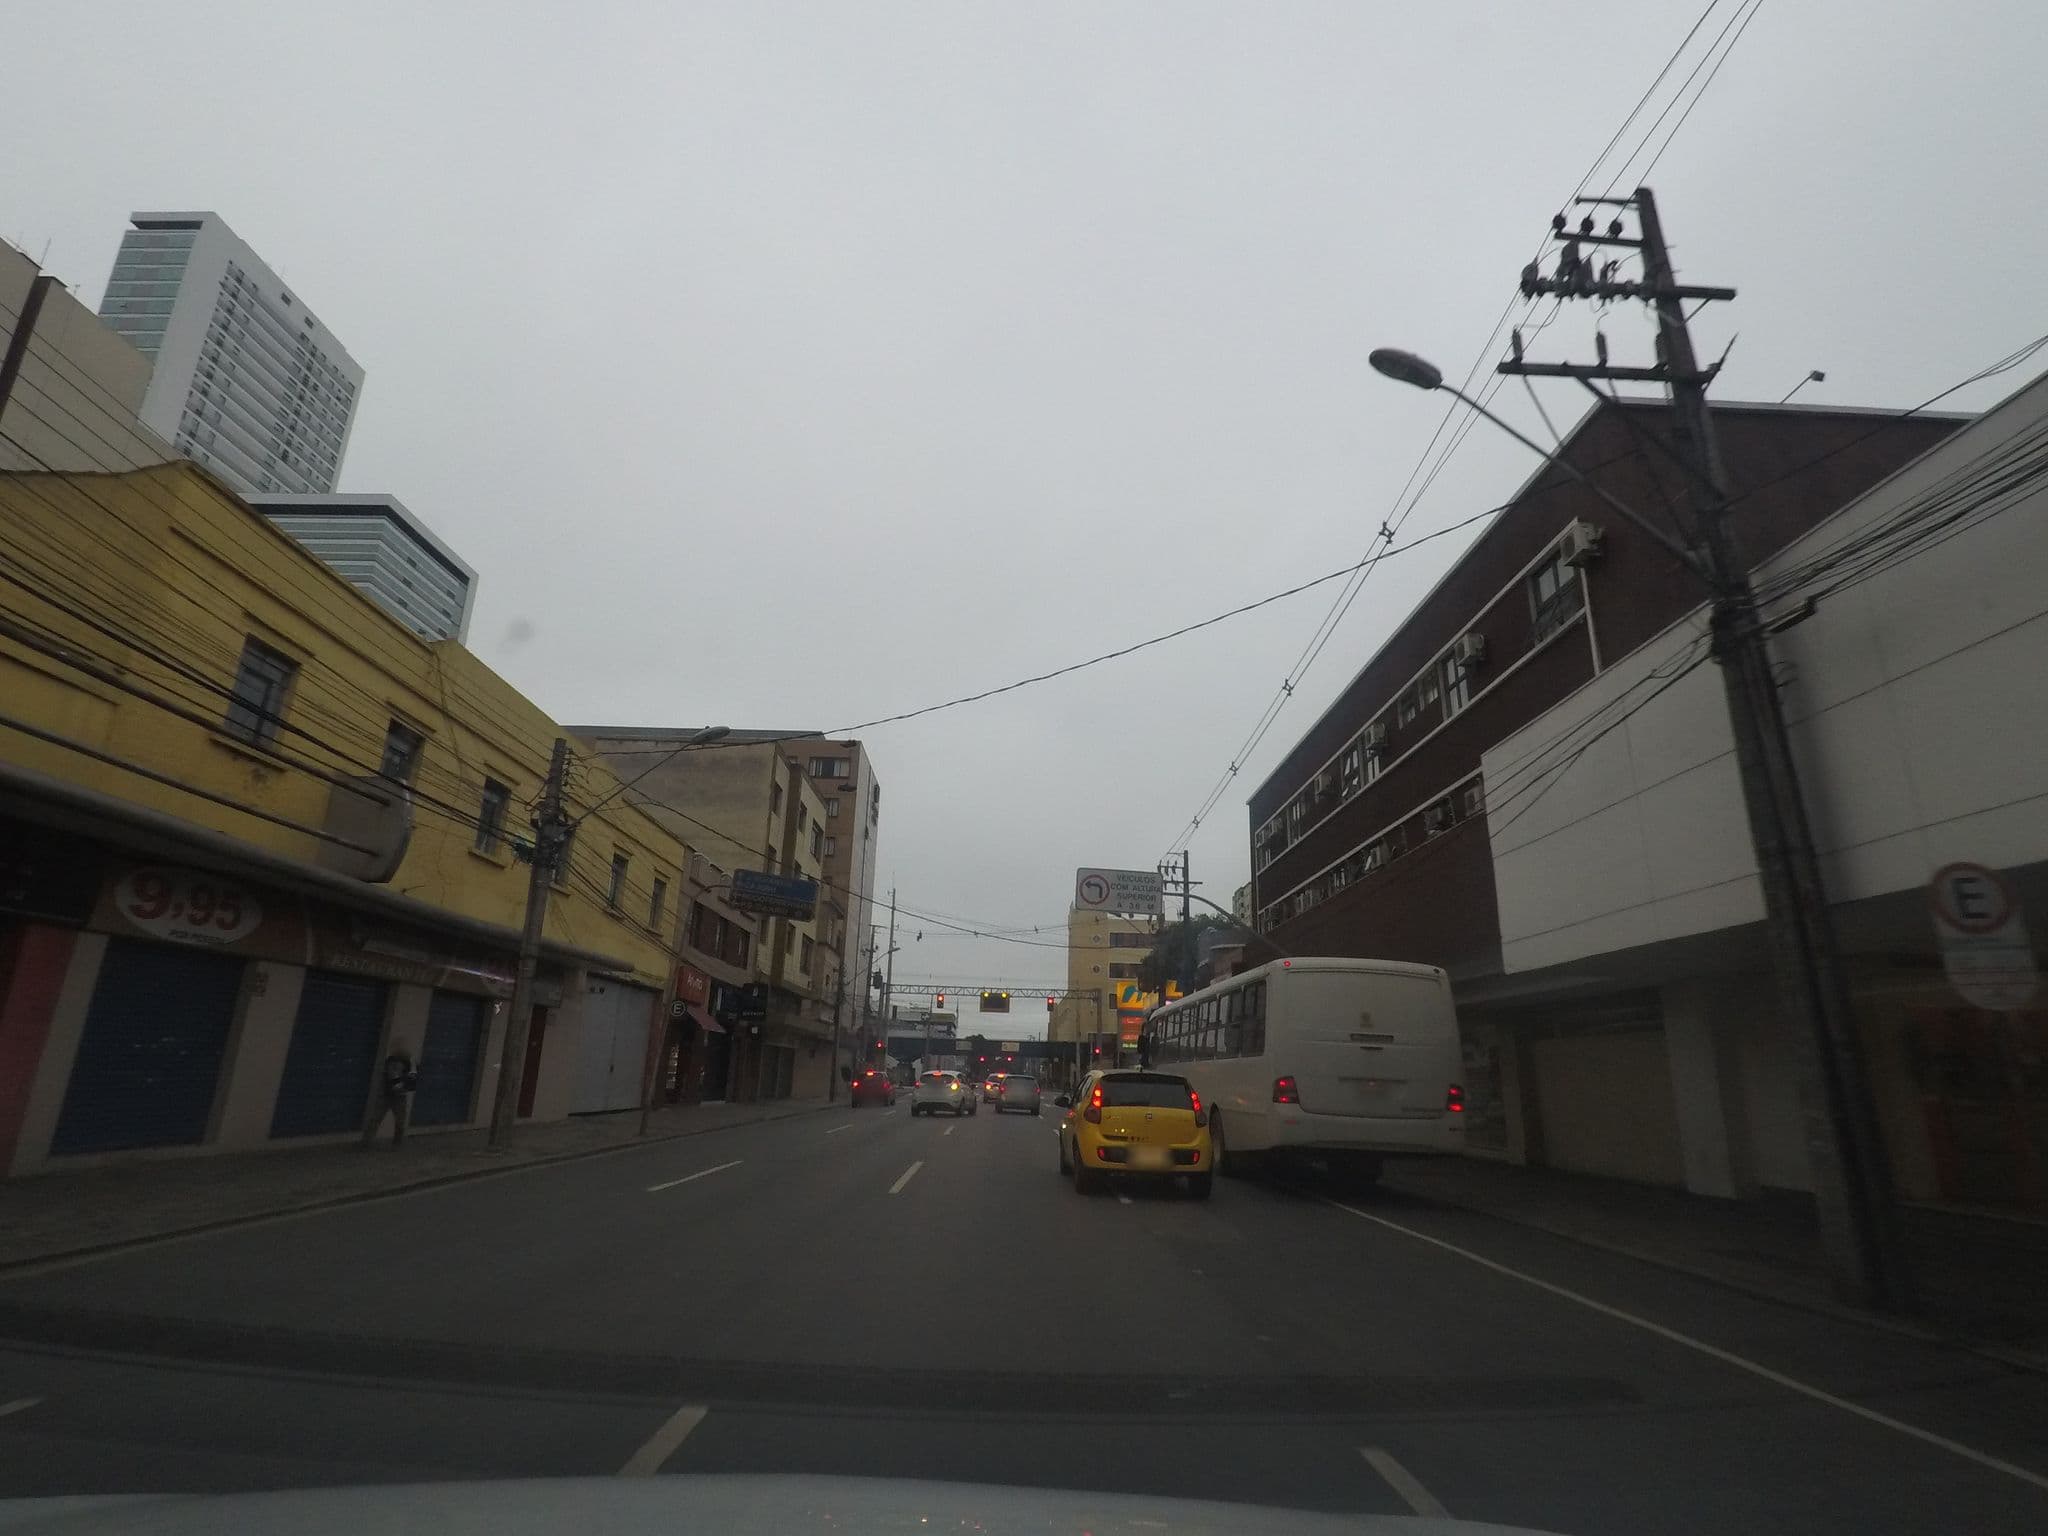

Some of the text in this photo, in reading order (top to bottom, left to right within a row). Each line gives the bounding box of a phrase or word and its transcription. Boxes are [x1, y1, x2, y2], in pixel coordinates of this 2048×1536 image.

[1110, 882, 1129, 891] COM
[1117, 892, 1157, 902] SUPERIOR
[1951, 877, 1988, 919] E
[673, 1004, 681, 1013] E
